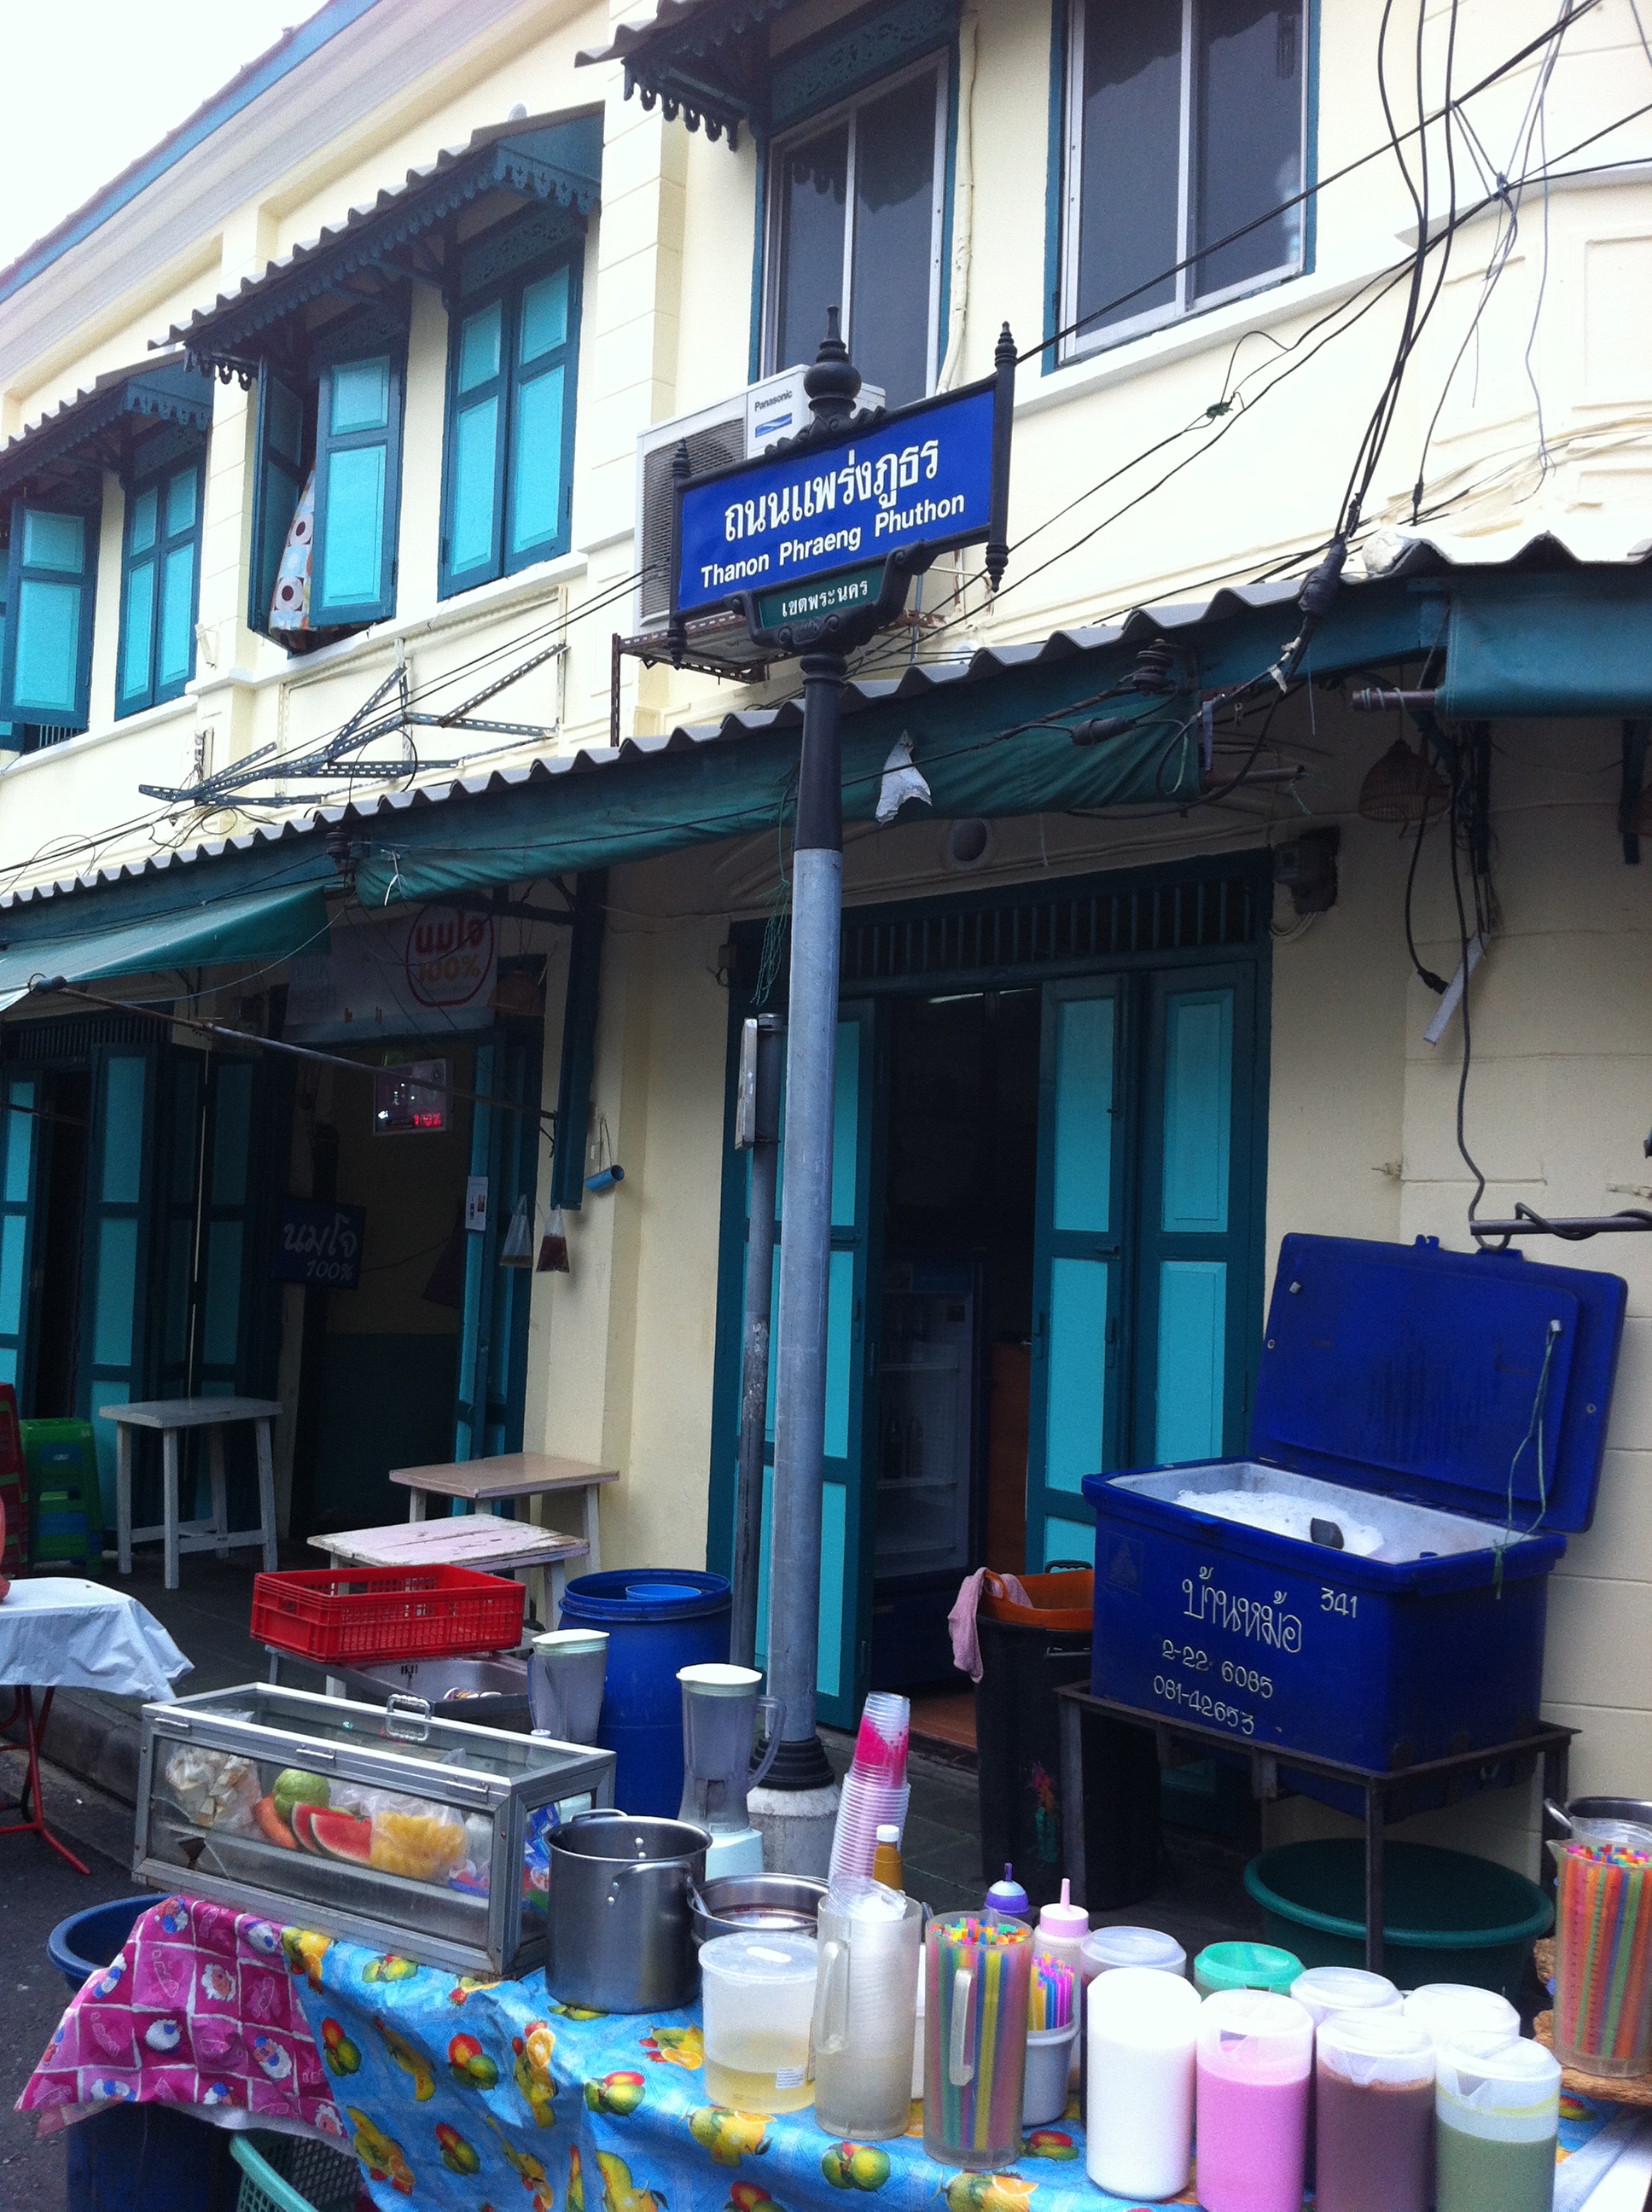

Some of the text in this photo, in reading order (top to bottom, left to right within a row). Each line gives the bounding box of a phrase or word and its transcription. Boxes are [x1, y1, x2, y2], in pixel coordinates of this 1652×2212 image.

[754, 389, 793, 412] Panasonic
[724, 439, 939, 542] ถนนแพร่งภูธร
[701, 494, 965, 588] Thanon Phraeng Phuthon
[782, 580, 868, 618] เขตพระนคร
[418, 955, 481, 984] 100%
[306, 1259, 354, 1282] 100%
[1182, 1566, 1302, 1653] บ้านหม้อ
[1320, 1586, 1358, 1618] 341
[1221, 1661, 1273, 1699] 6085
[1154, 1675, 1254, 1735] 081-42653
